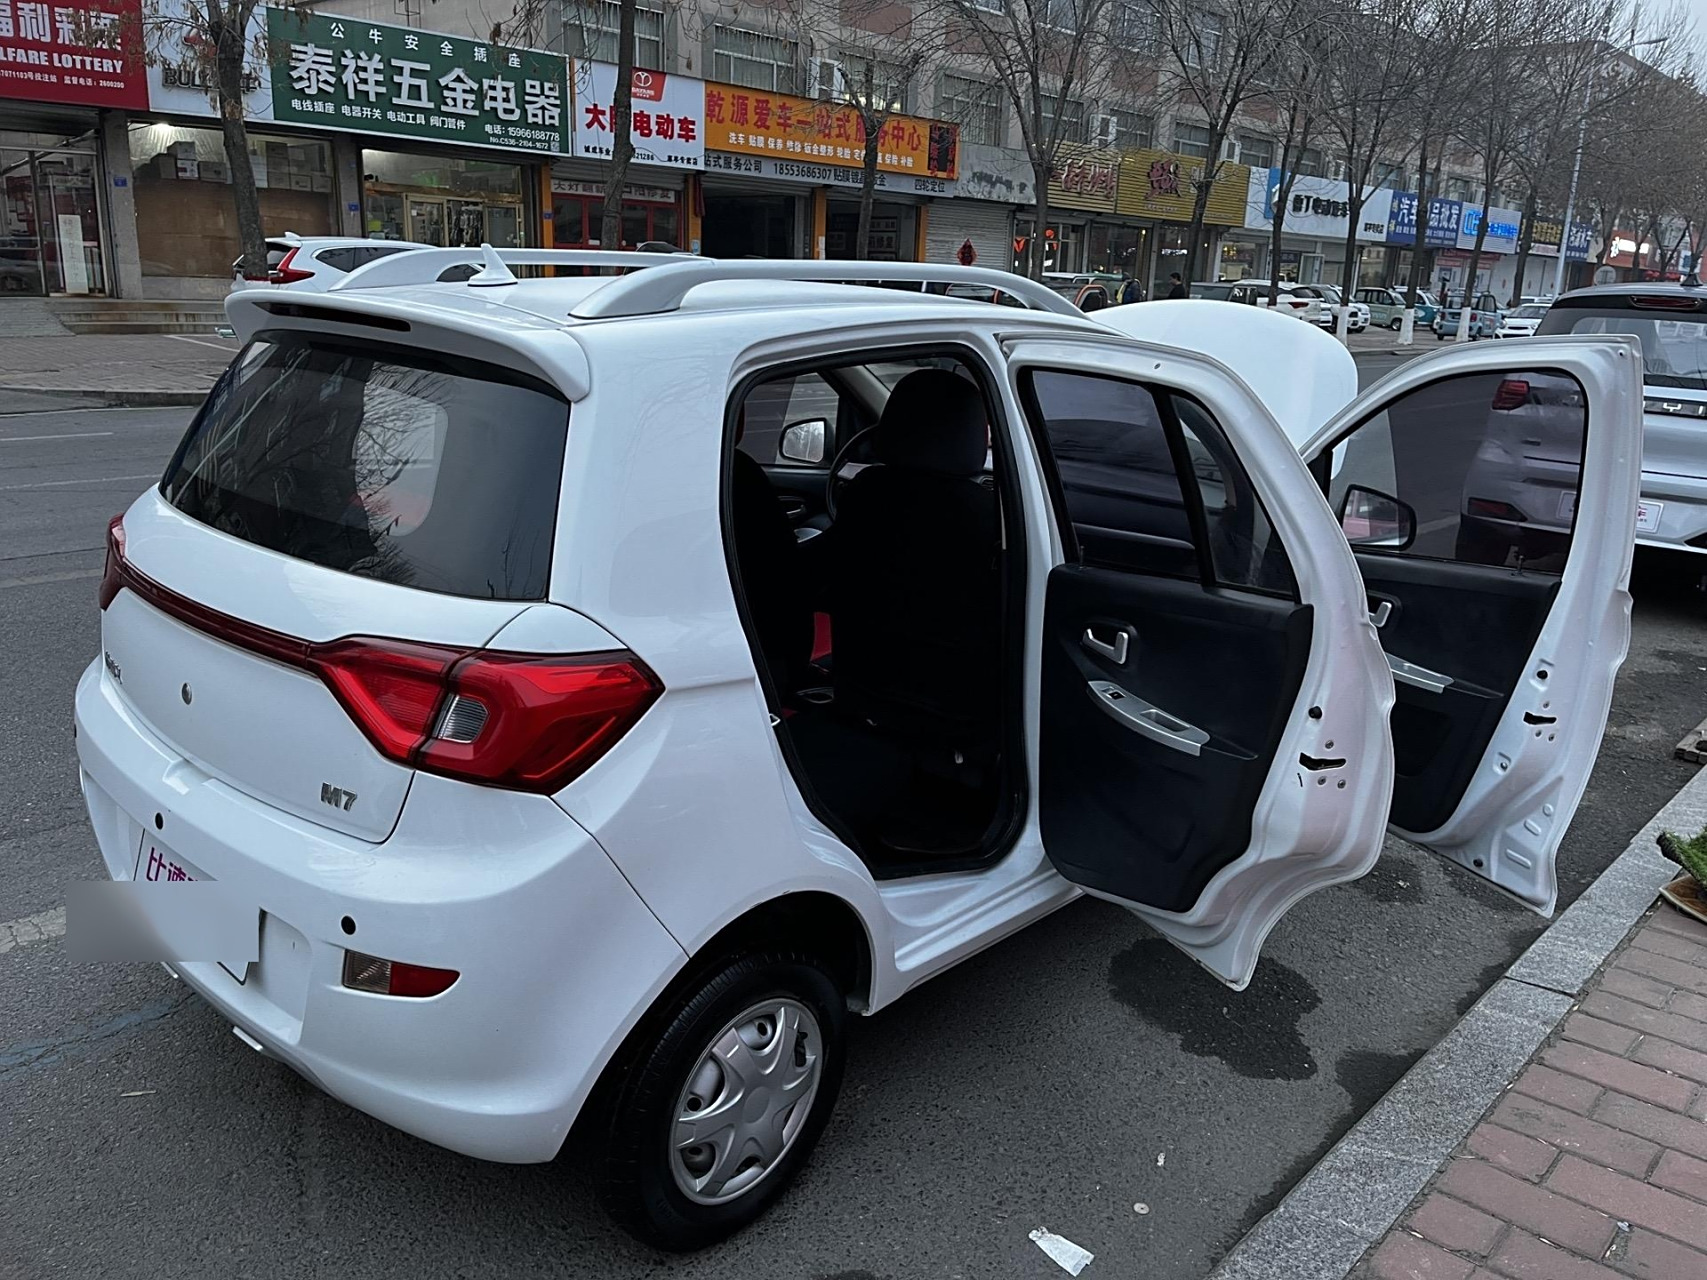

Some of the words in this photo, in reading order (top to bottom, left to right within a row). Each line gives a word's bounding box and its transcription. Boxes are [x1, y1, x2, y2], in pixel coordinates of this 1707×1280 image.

[331, 21, 521, 68] 公牛安全插座
[53, 53, 123, 73] LOTTERY
[290, 43, 561, 127] 泰祥五金电器
[291, 98, 335, 114] 电线插座
[341, 105, 382, 120] 电器开关
[386, 110, 425, 125] 电动工具
[585, 103, 697, 143] 大电动车
[774, 163, 832, 179] 18553686307
[914, 178, 946, 193] 四轮定位
[320, 781, 357, 811] M7
